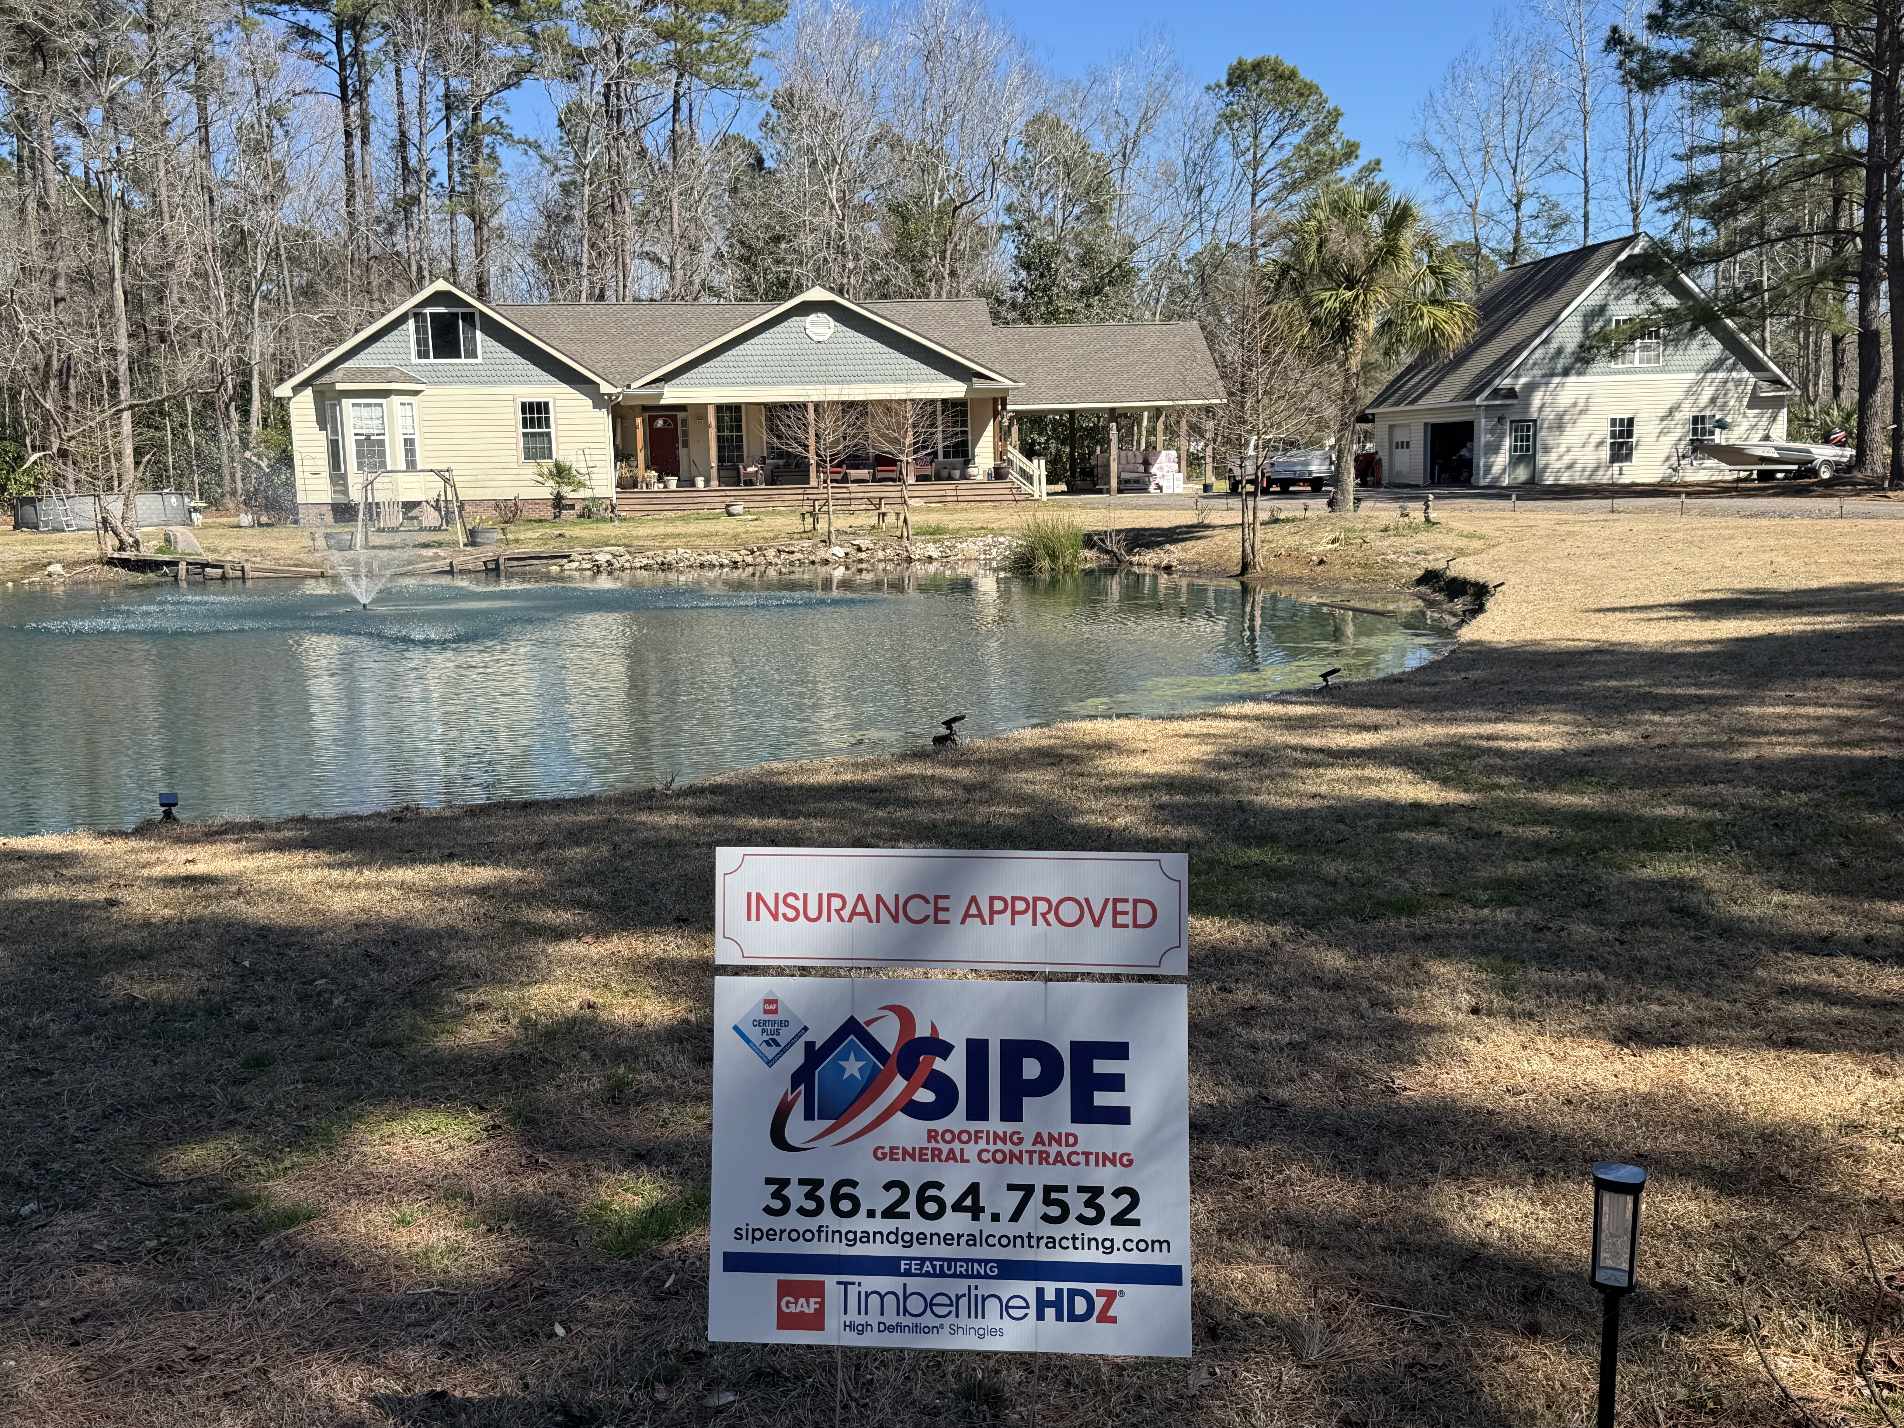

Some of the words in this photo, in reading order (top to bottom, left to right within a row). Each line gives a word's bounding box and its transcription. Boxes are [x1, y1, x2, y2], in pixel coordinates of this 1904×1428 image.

[746, 891, 951, 925] INSURANCE
[960, 895, 1158, 929] APPROVED
[752, 1019, 790, 1028] CERTIFIED
[761, 1028, 781, 1037] PLUS
[896, 1036, 1132, 1126] SIPE
[927, 1128, 1024, 1147] ROOFING
[1031, 1131, 1079, 1148] AND
[872, 1145, 970, 1164] GENERAL
[981, 1148, 1134, 1169] CONTRACTING
[762, 1177, 1141, 1227] 336.264.7532
[733, 1223, 1171, 1255] siperoofingandgeneralcontracting.com
[900, 1260, 999, 1277] FEATURING
[780, 1297, 821, 1314] GAF
[836, 1280, 1030, 1322] Timberline
[843, 1320, 873, 1336] High
[948, 1323, 1004, 1340] Shingles
